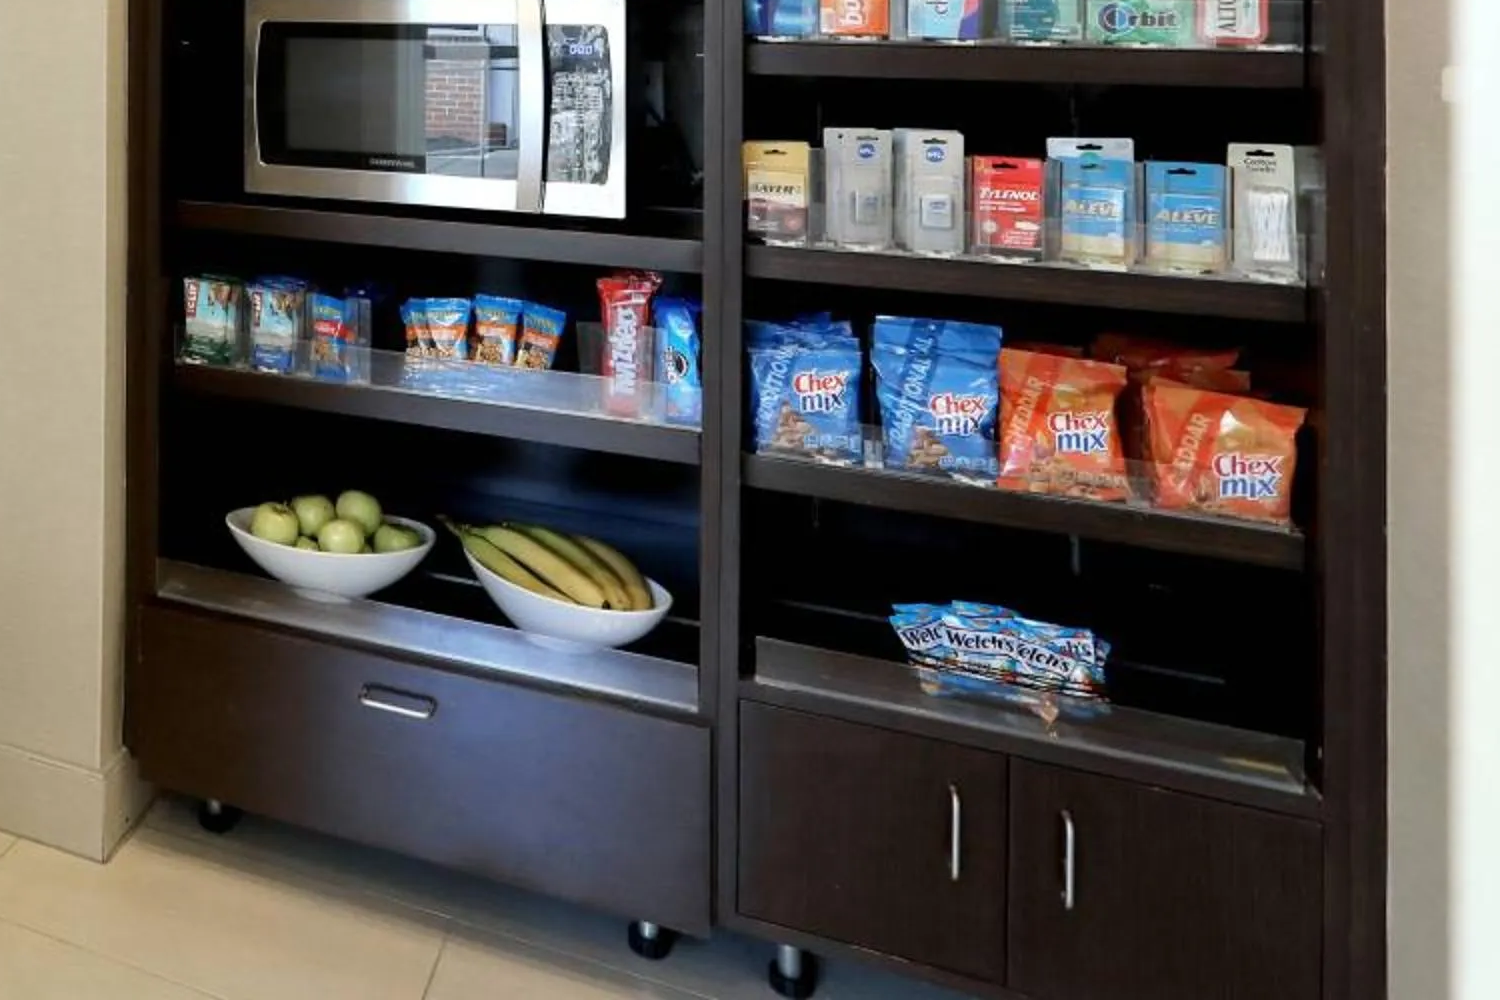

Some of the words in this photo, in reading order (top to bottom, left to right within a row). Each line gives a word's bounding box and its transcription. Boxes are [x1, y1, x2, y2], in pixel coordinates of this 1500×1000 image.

[1098, 2, 1178, 35] Orbit
[979, 186, 1041, 202] TYLENOL
[1154, 209, 1221, 226] ALEVE
[794, 370, 848, 394] Chex
[801, 392, 844, 413] mix
[930, 394, 988, 416] Chex
[936, 413, 983, 435] mix
[1050, 411, 1108, 433] Chex
[1056, 429, 1108, 454] mix
[1213, 453, 1283, 478] Chex
[1219, 475, 1278, 499] mix
[946, 630, 1015, 652] Welch's
[1017, 643, 1071, 673] elch's
